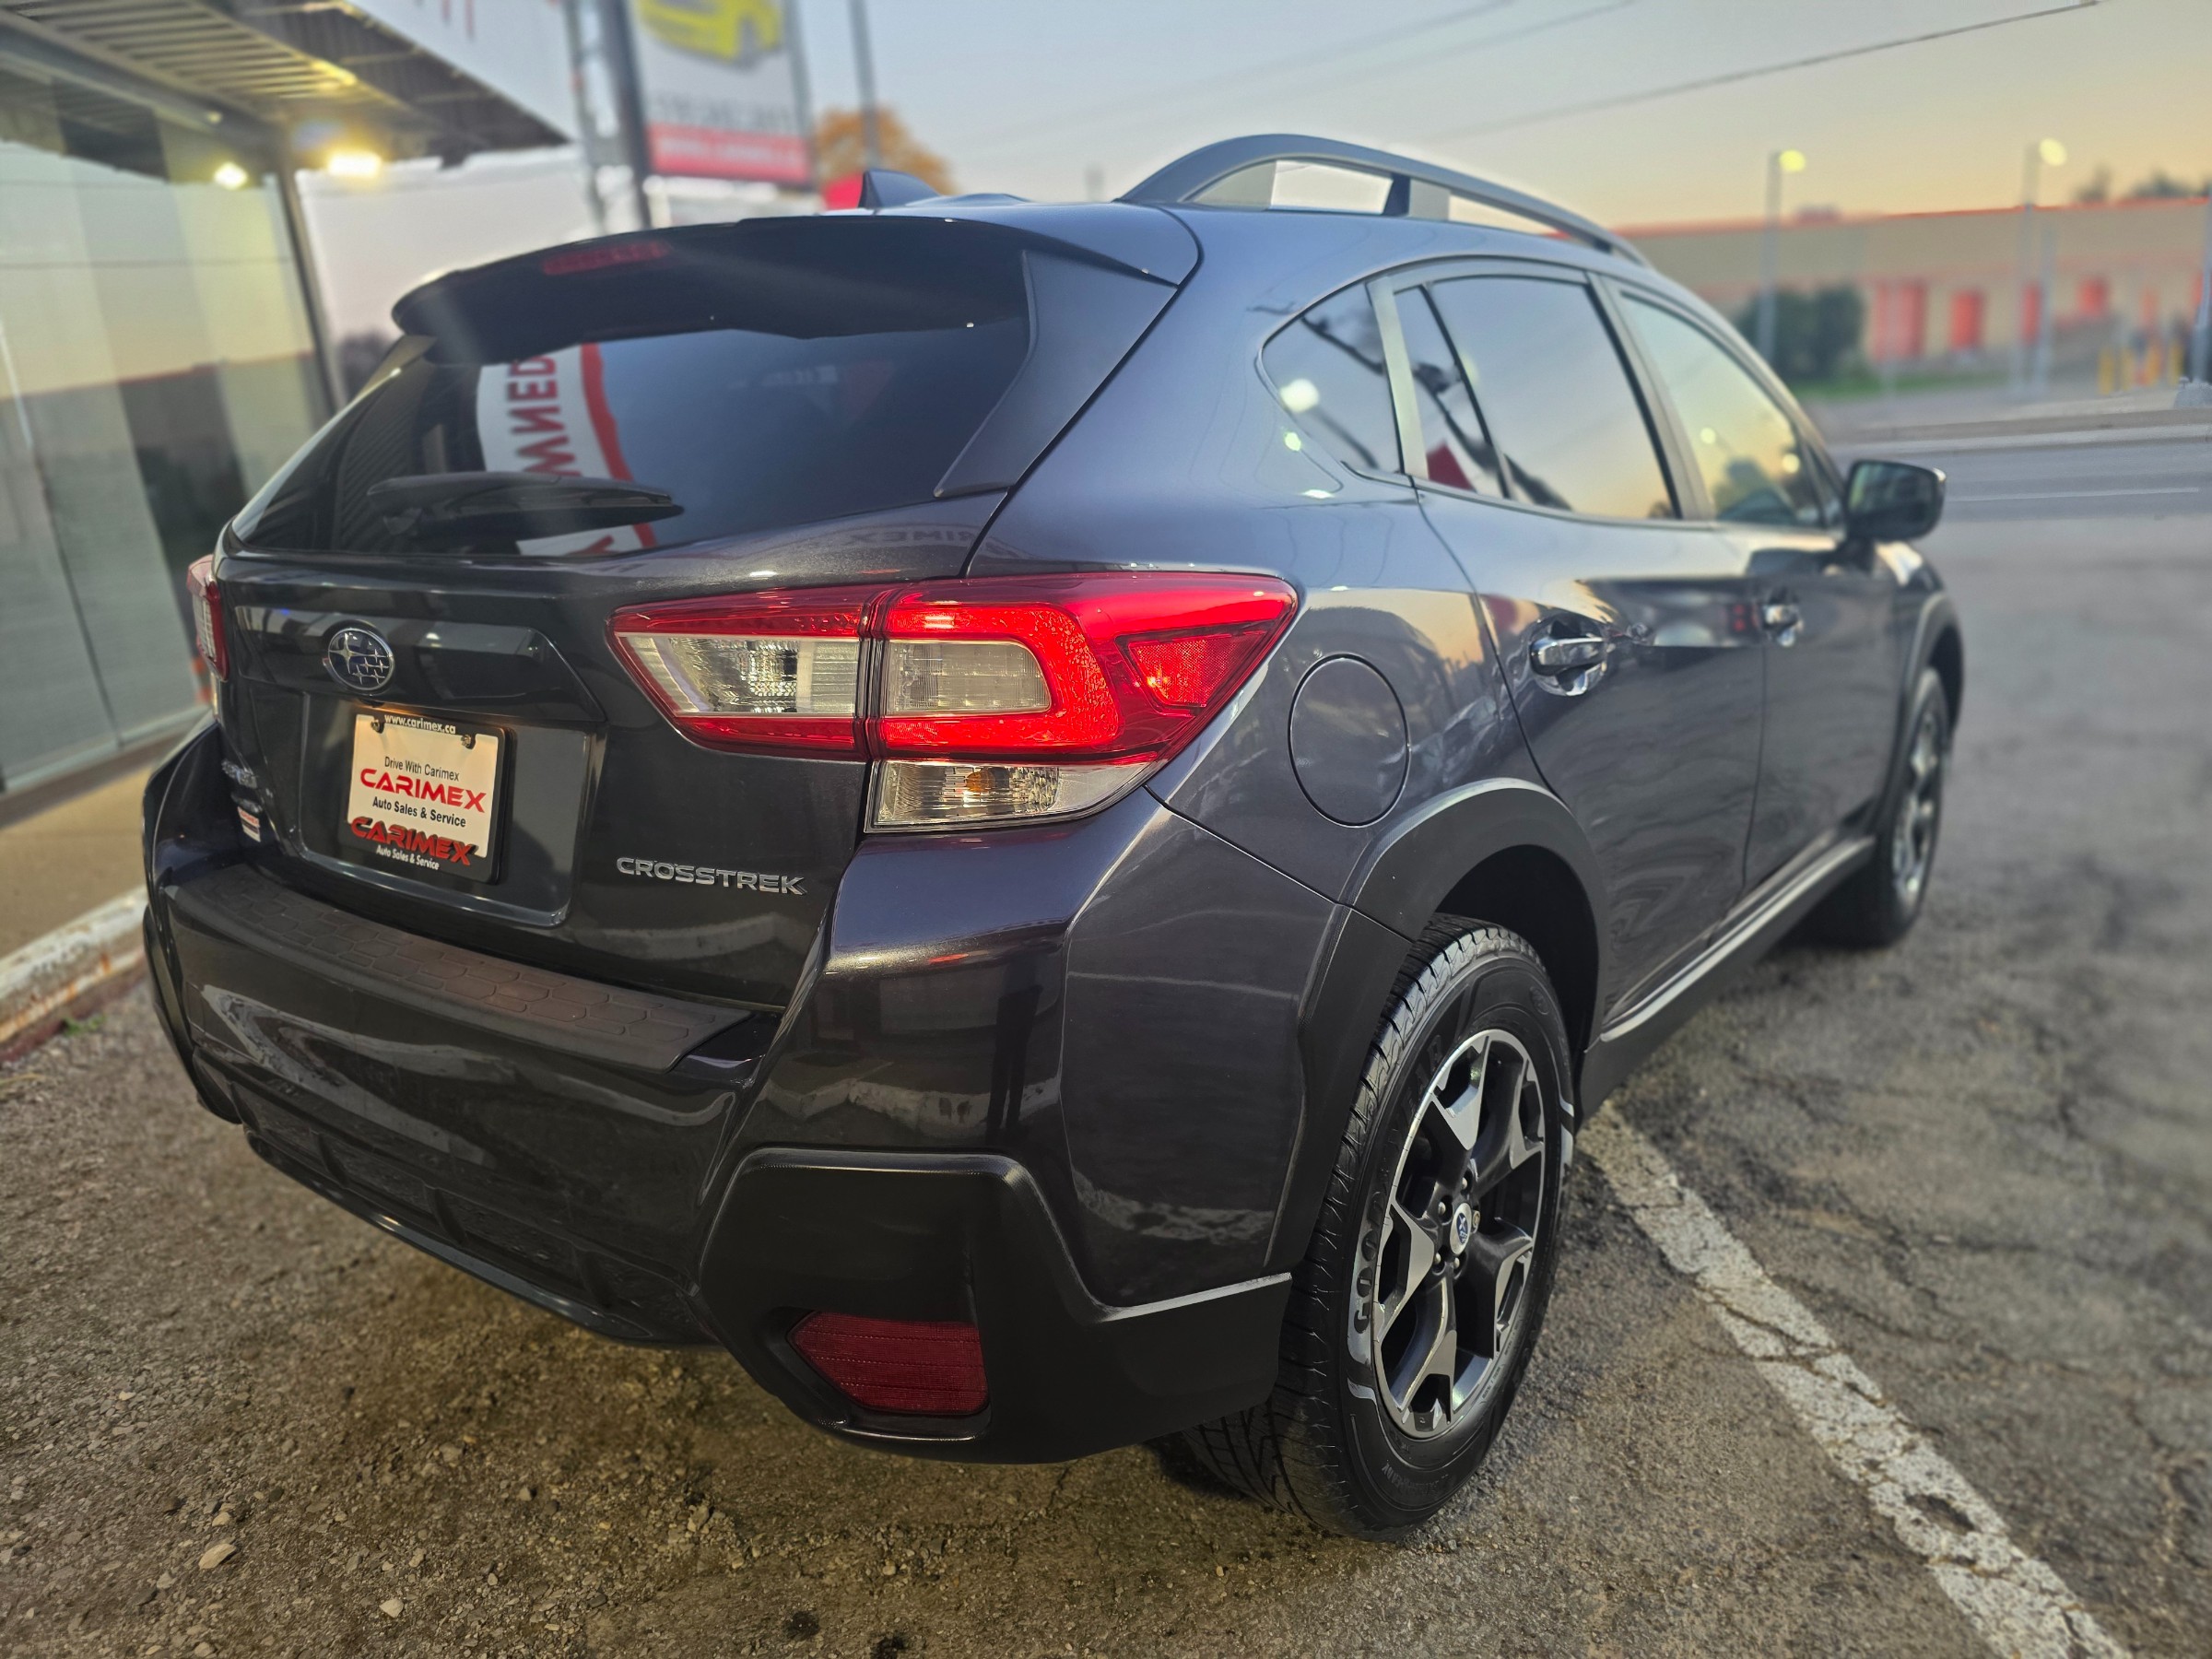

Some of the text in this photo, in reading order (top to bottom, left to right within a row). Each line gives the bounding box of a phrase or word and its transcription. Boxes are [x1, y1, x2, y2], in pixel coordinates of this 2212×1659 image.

[383, 713, 456, 735] www.carimex.ca
[384, 756, 460, 782] Drive With Carimex
[359, 768, 487, 813] CARIMEX
[372, 796, 466, 828] Auto Sales & Service
[350, 816, 477, 866] CARIMEX
[376, 844, 440, 871] Auto Sales & Service
[616, 856, 808, 896] CROSSTREK
